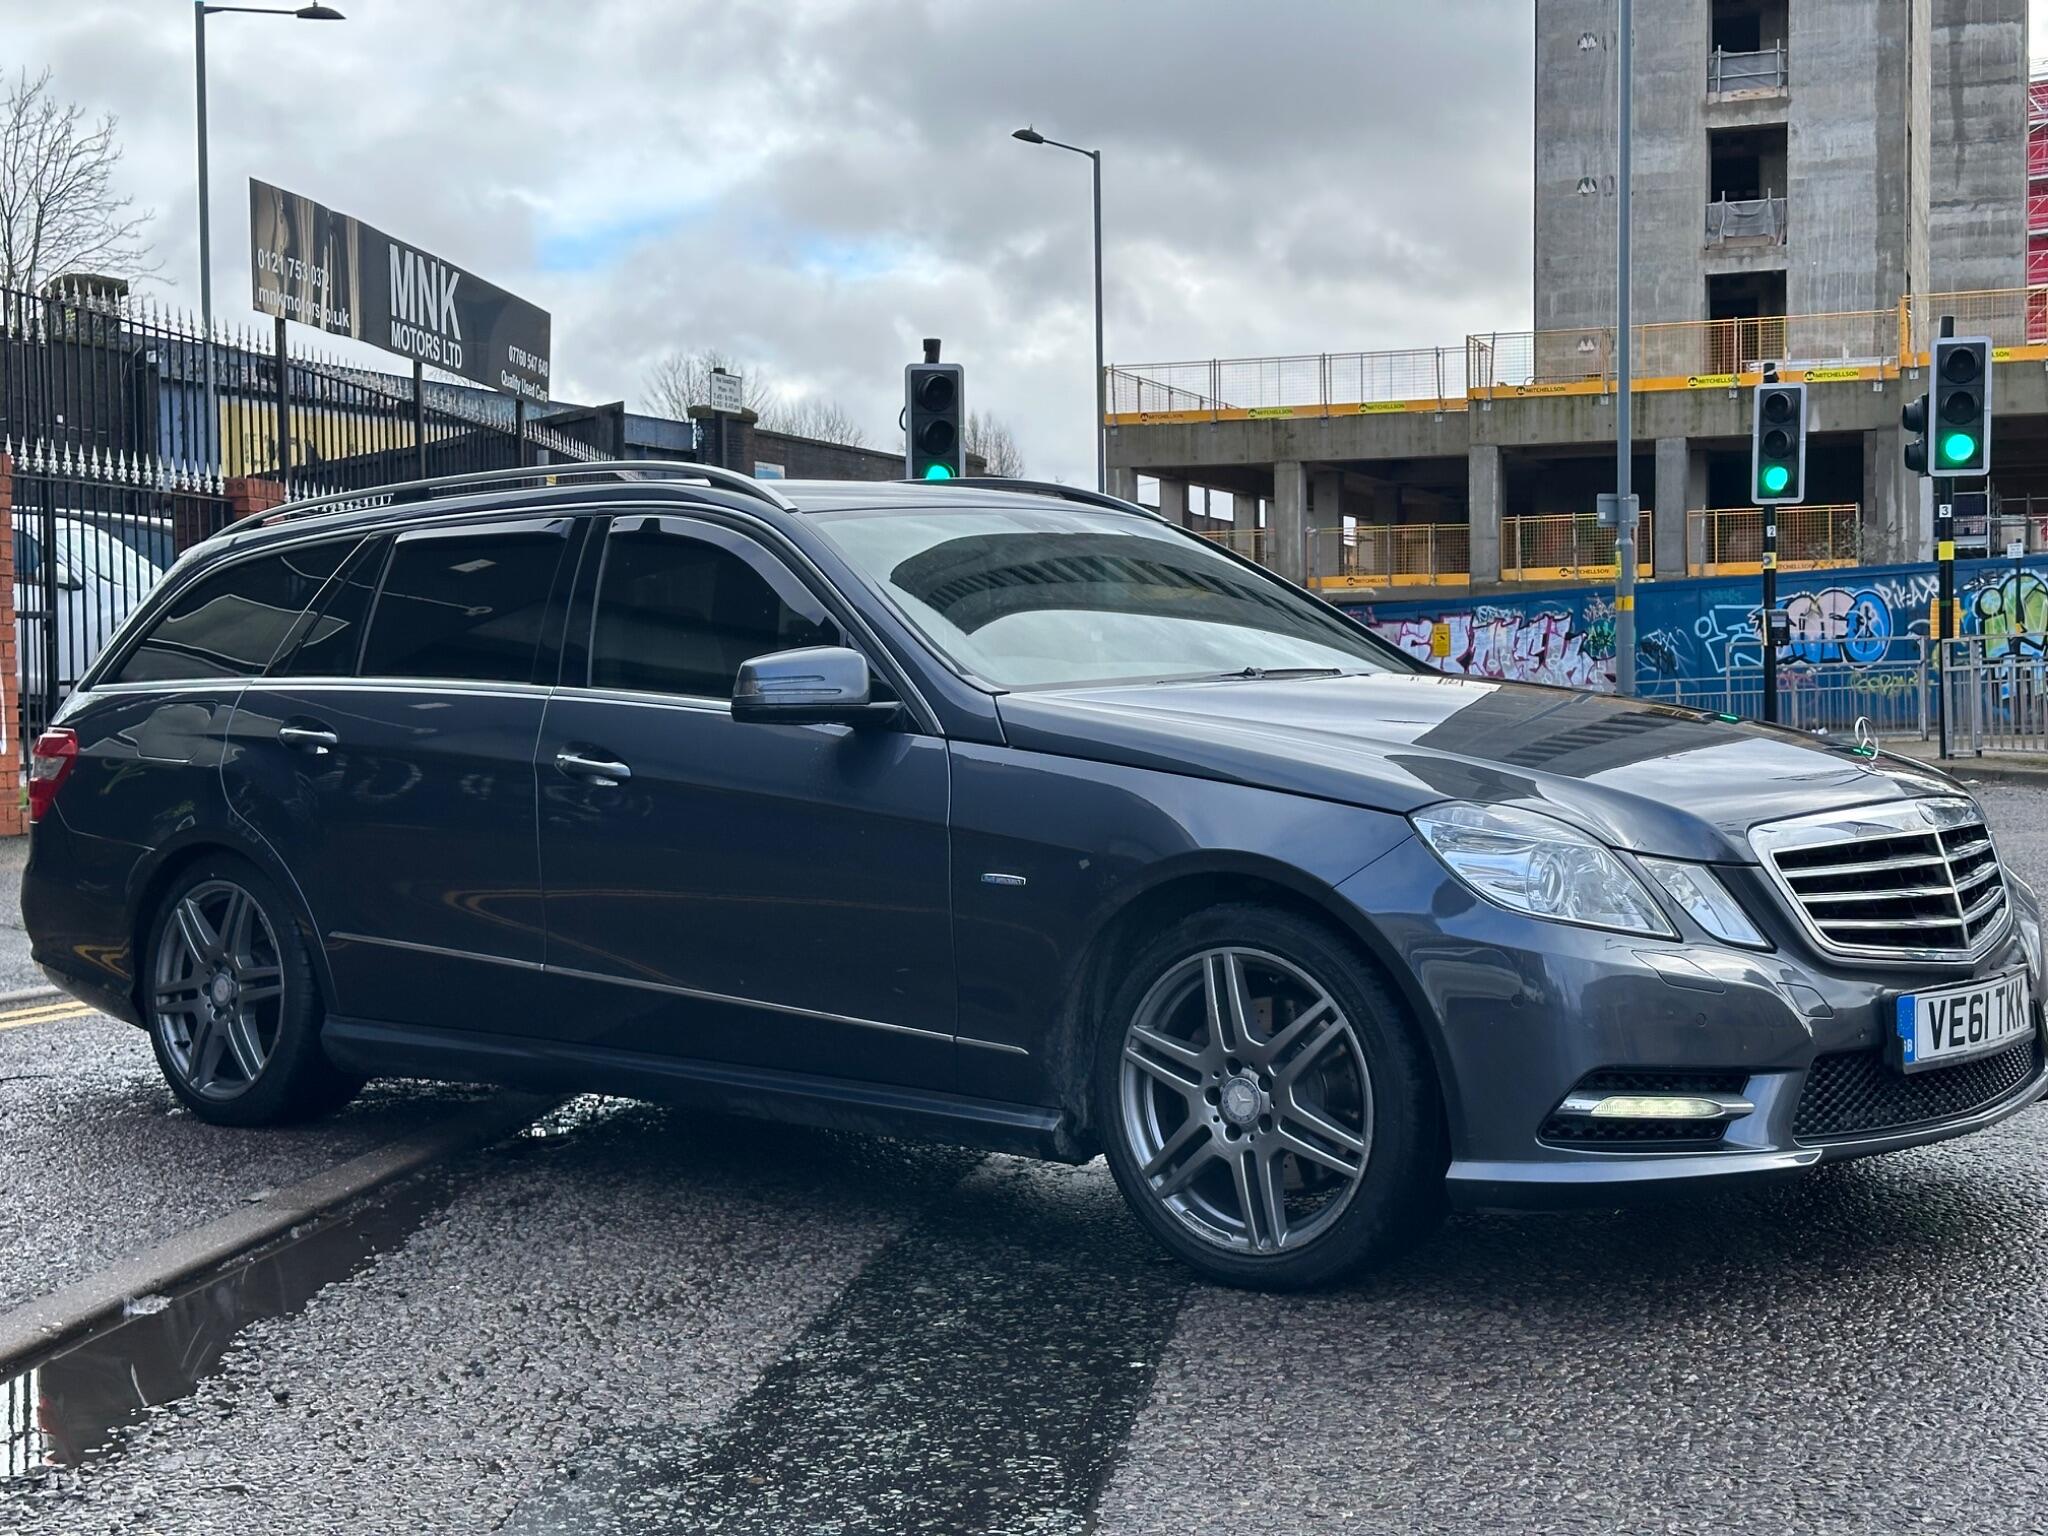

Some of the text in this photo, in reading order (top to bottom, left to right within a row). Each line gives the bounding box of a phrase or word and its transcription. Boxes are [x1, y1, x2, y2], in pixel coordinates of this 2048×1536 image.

[258, 248, 284, 275] 0121
[288, 257, 308, 282] 753
[389, 243, 461, 340] MNK
[391, 320, 462, 369] MOTORS LTD
[502, 370, 548, 402] Quality Used Cars
[1941, 505, 1949, 516] 3
[1928, 978, 2025, 1050] VE61 TKK
